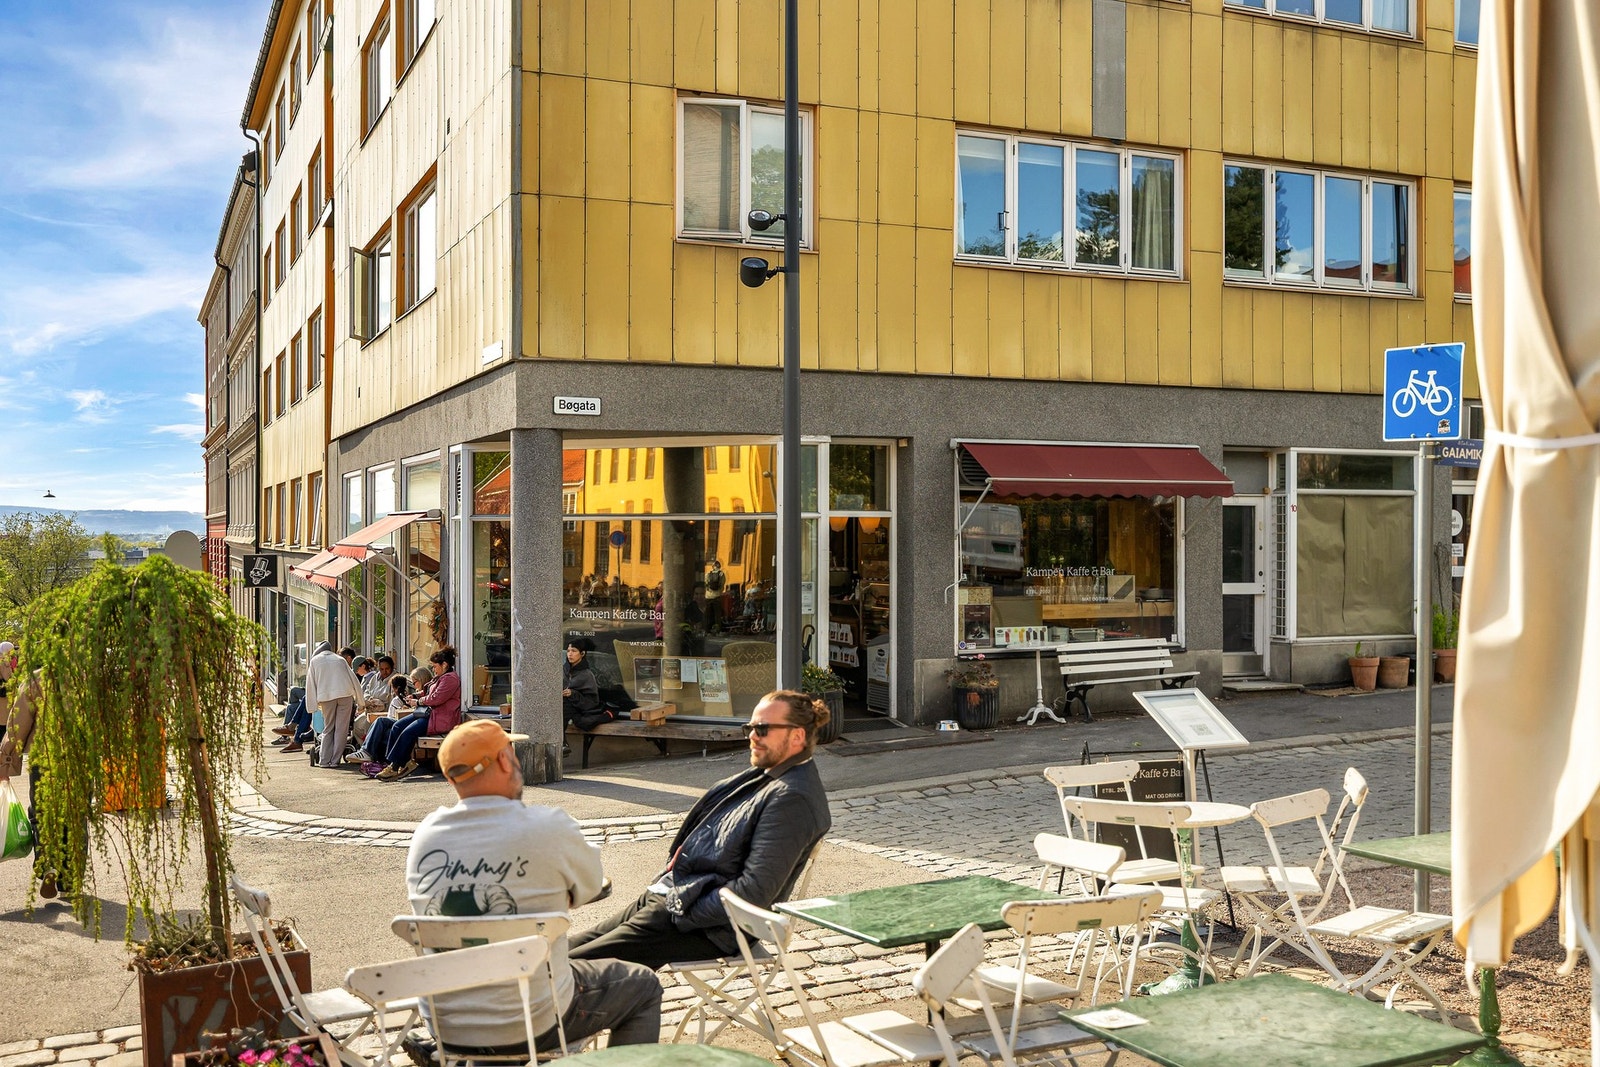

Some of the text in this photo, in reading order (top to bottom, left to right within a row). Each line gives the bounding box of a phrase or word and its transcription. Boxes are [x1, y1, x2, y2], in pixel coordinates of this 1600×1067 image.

[559, 399, 596, 412] Bøgata
[1290, 504, 1297, 512] 10
[1026, 566, 1116, 578] Kampen Kaffe & Bar
[569, 608, 667, 620] Kampen Kaffe & Bar
[1139, 768, 1161, 779] Kaffe
[1162, 768, 1169, 777] &
[416, 849, 529, 895] Jimmy's
